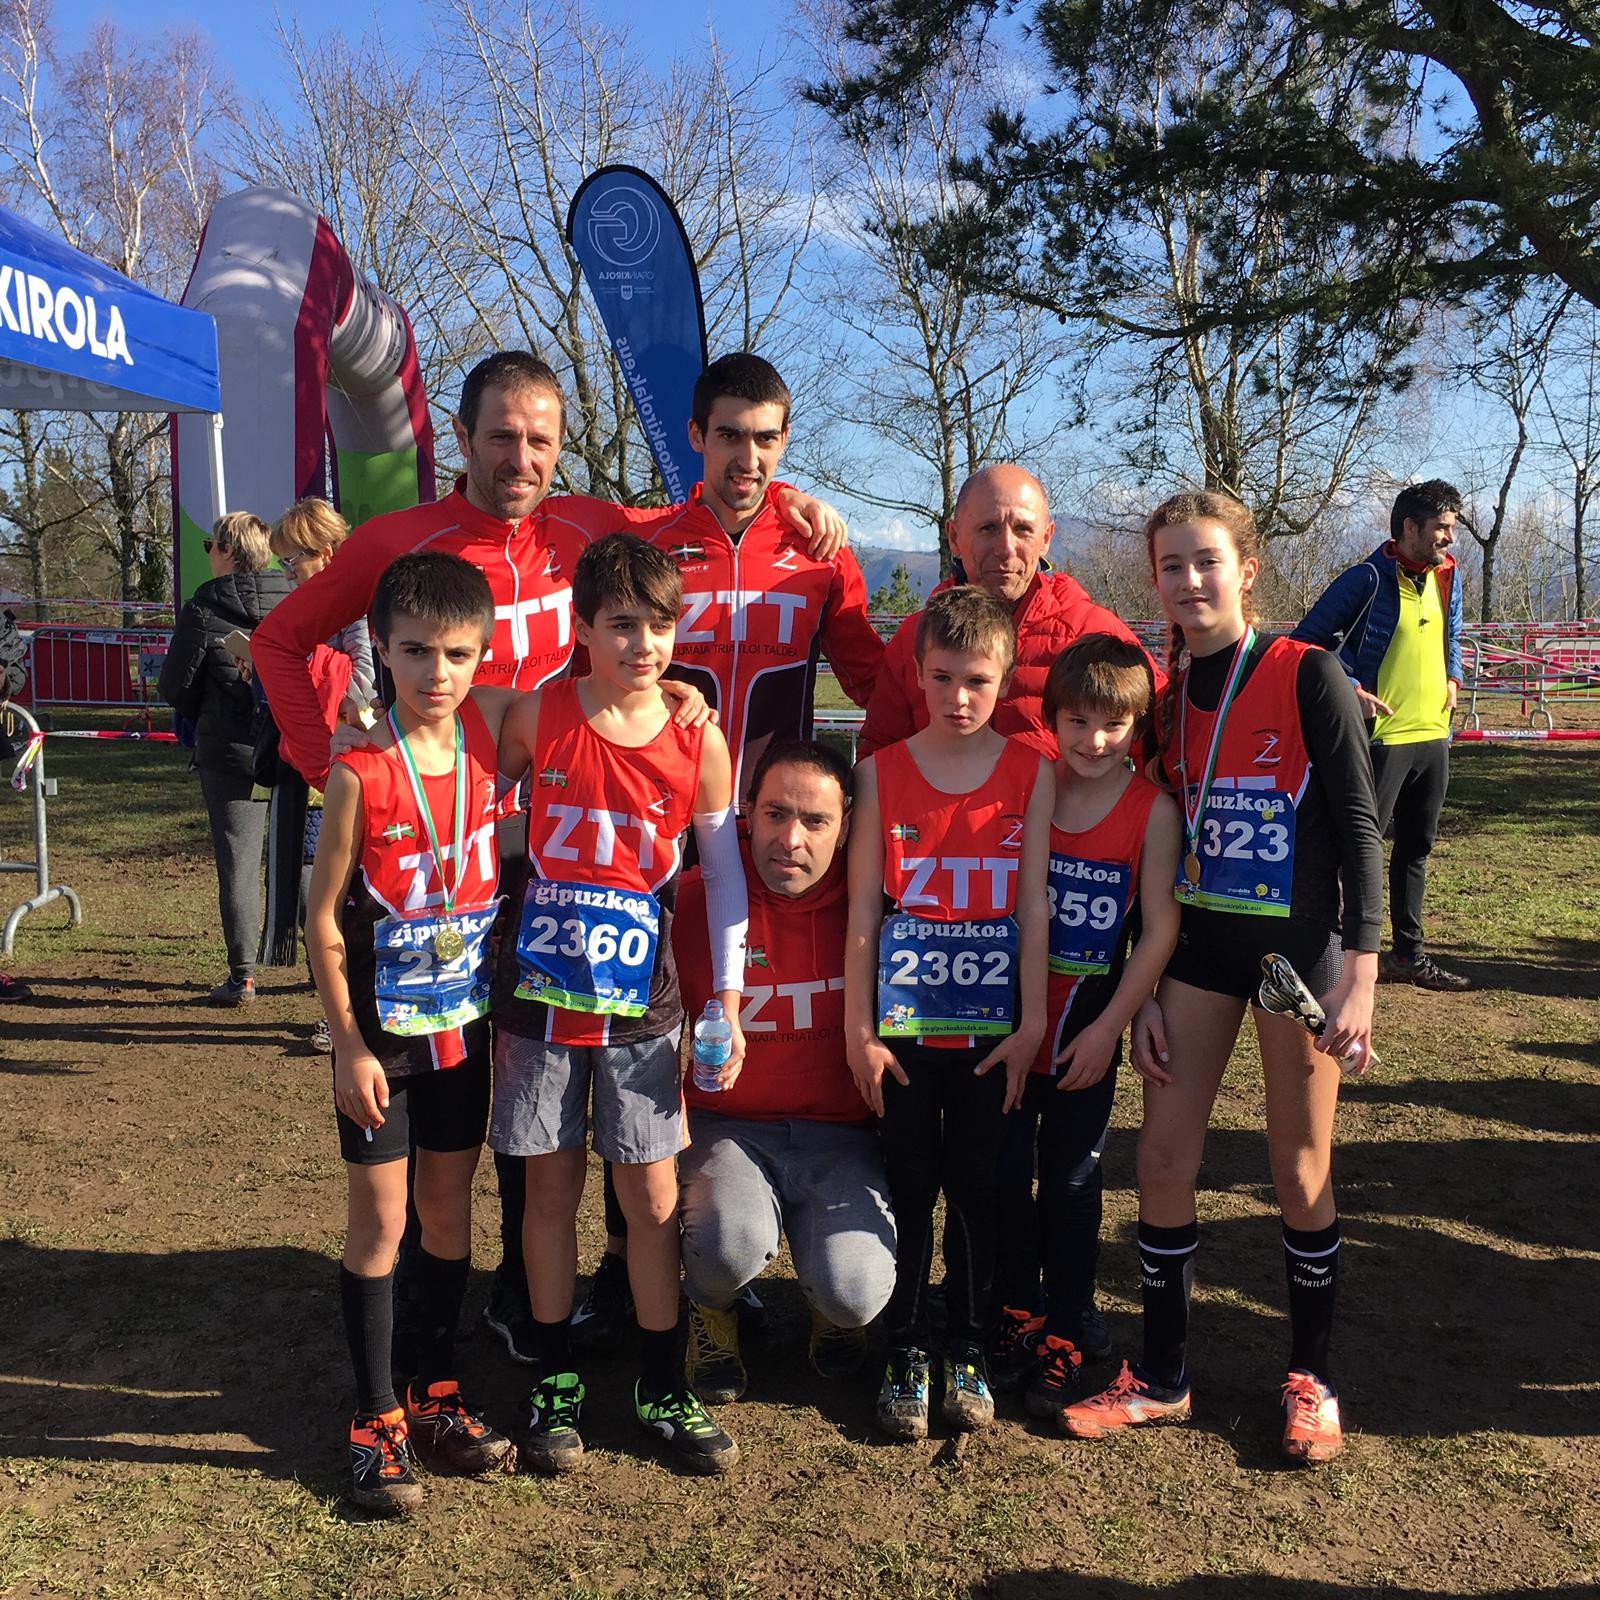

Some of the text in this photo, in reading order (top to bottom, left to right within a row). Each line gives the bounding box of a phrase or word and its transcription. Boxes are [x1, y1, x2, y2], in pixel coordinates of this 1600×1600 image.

[482, 587, 573, 661] TT
[674, 590, 807, 644] ZTT
[541, 803, 657, 869] ZTT
[534, 883, 650, 915] gipuzkoa
[900, 857, 1019, 910] ZTT
[525, 915, 650, 967] 2360
[892, 919, 1009, 940] gipuzkoa
[889, 950, 1010, 985] 2362
[1293, 1275, 1333, 1288] SPORTLAST
